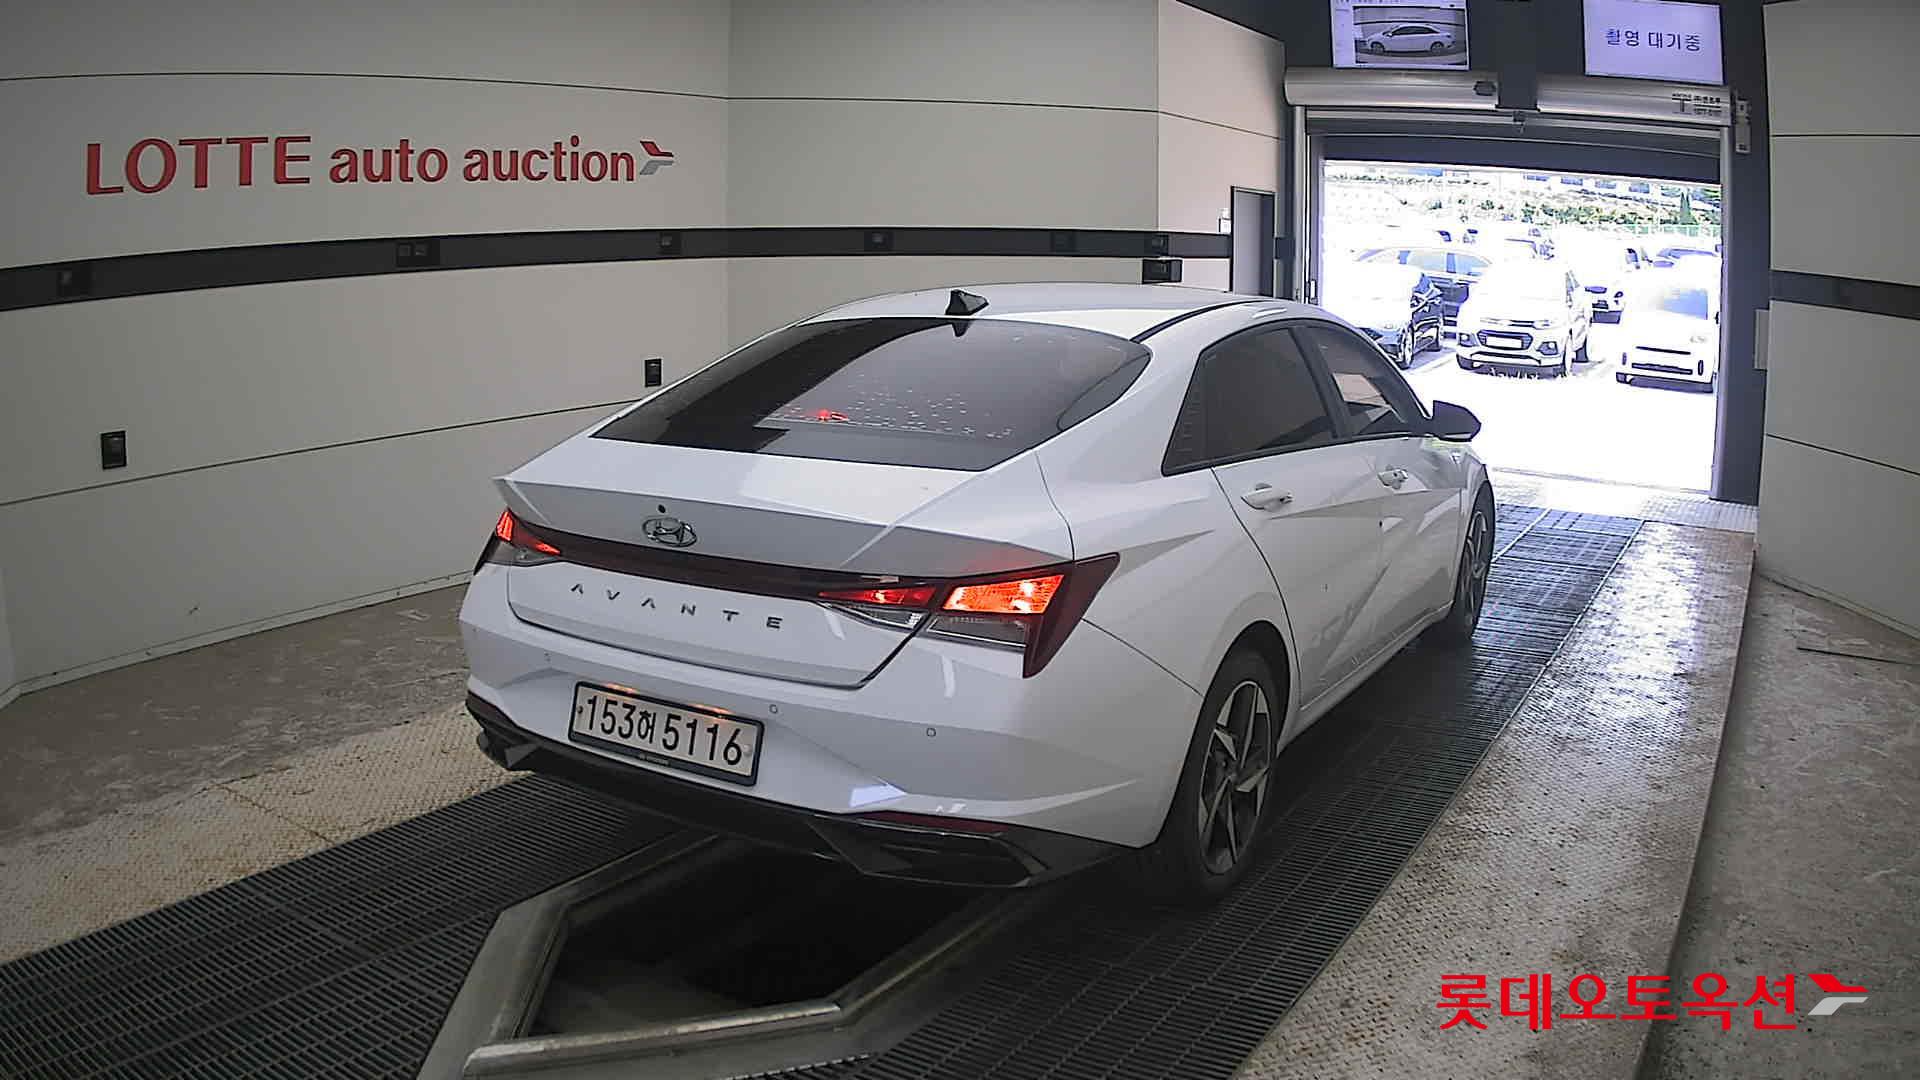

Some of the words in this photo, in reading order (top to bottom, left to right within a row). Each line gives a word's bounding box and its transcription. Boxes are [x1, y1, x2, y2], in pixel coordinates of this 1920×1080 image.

[1647, 31, 1701, 52] 대기중
[86, 136, 311, 194] LOTTE
[329, 138, 448, 183] auto
[463, 136, 635, 182] auction
[570, 583, 784, 629] AVANTE
